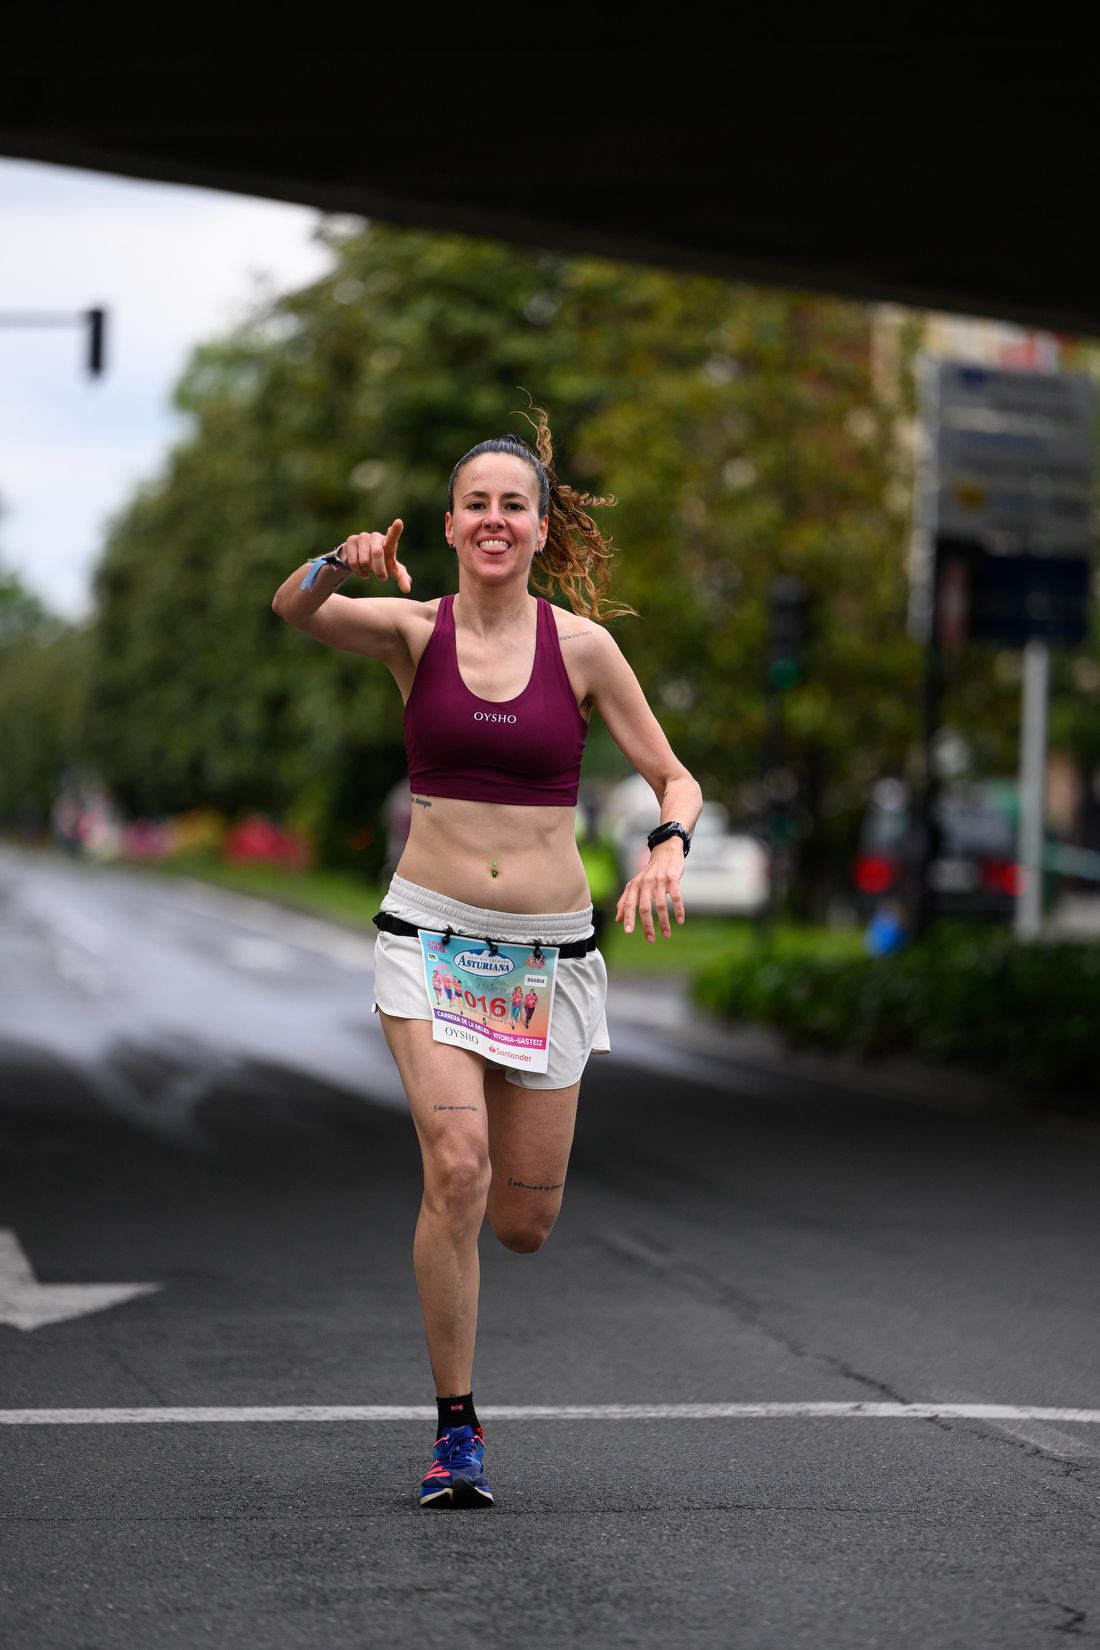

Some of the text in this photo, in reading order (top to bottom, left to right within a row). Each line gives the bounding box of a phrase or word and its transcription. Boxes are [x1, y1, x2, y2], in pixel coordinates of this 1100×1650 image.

[473, 711, 517, 724] OYSHO
[458, 954, 510, 972] ASTURIANA
[464, 990, 507, 1017] 016
[436, 1010, 460, 1024] CARRERA
[461, 1017, 468, 1026] DE
[468, 1020, 475, 1029] LA
[475, 1023, 490, 1036] MUJER
[445, 1026, 479, 1045] OYSHO
[496, 1047, 533, 1062] Santander
